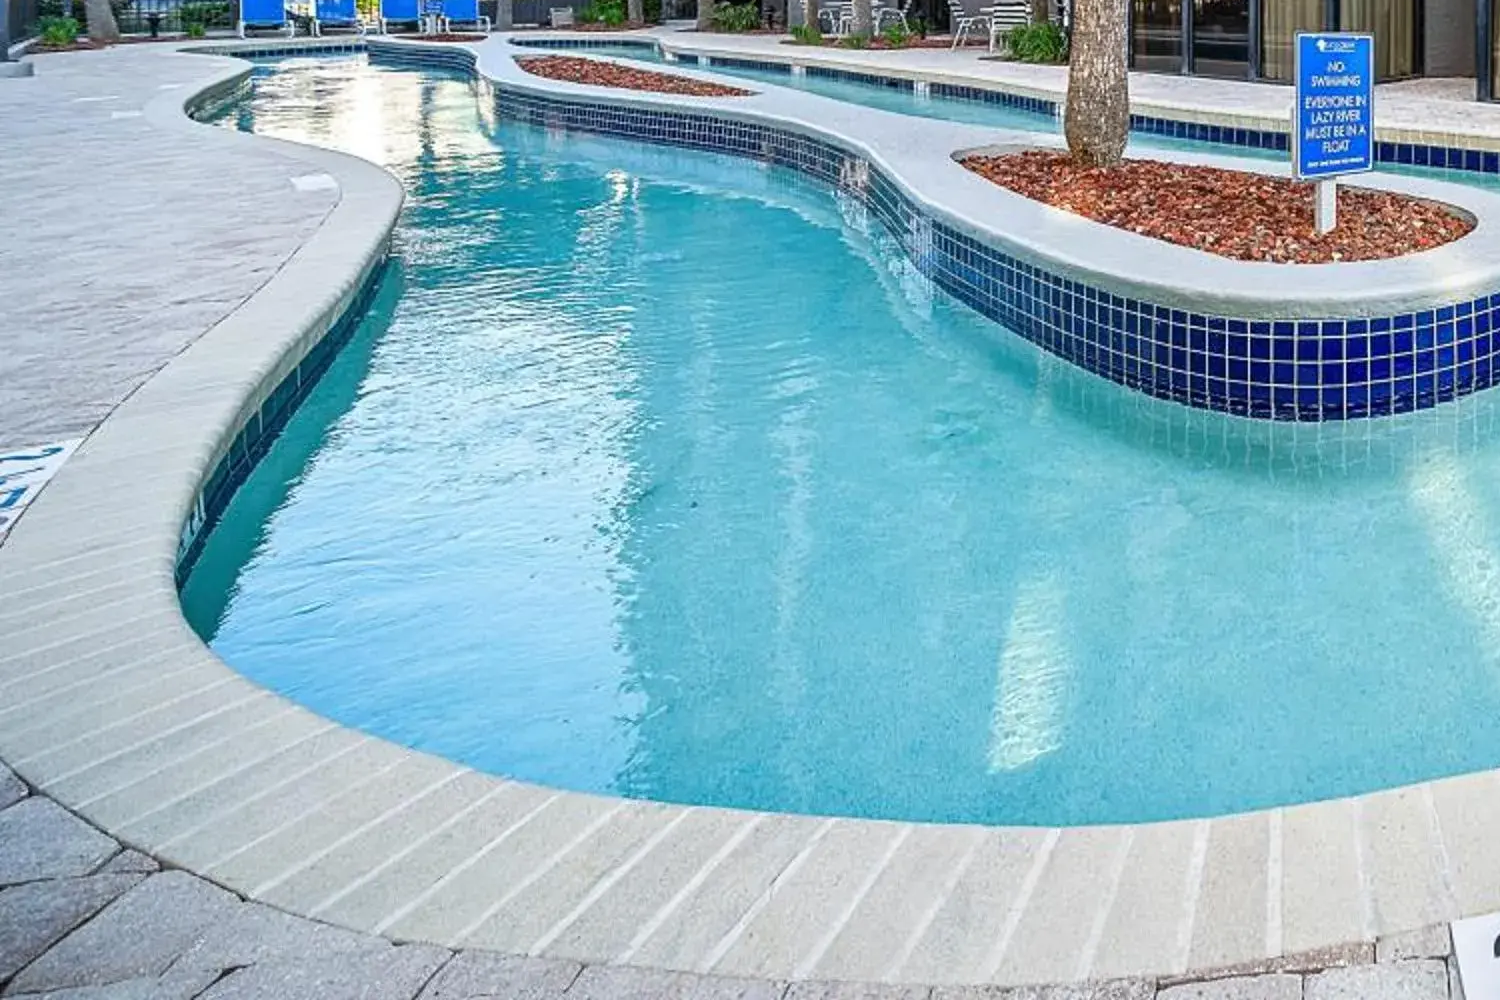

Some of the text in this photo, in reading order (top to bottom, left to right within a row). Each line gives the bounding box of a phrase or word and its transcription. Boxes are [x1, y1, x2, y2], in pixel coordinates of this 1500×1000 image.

[1327, 61, 1345, 72] NO
[1311, 75, 1361, 88] SWIMMING
[1305, 95, 1367, 109] EVERYONE IN
[1311, 109, 1361, 125] LAZY RIVER
[1305, 123, 1367, 140] MUST BE IN A
[1322, 139, 1351, 153] FLOAT
